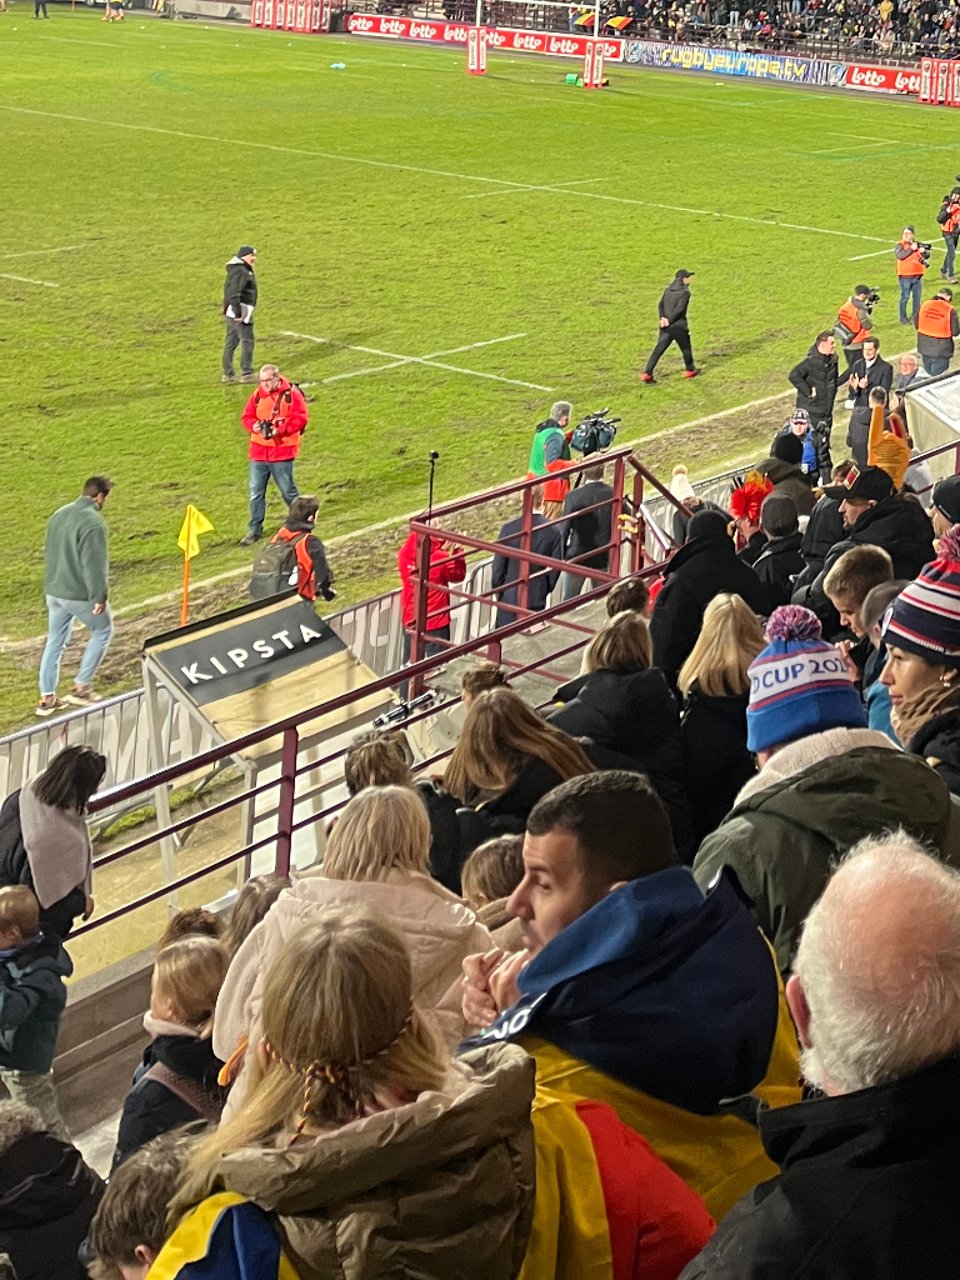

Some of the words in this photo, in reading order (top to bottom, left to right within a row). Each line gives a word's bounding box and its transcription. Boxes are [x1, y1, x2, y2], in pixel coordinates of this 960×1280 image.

[348, 18, 373, 32] otto
[661, 48, 807, 79] rugbyeurope.tv
[895, 72, 921, 91] Lott
[180, 624, 322, 685] KIPSTA
[762, 663, 805, 688] CUP
